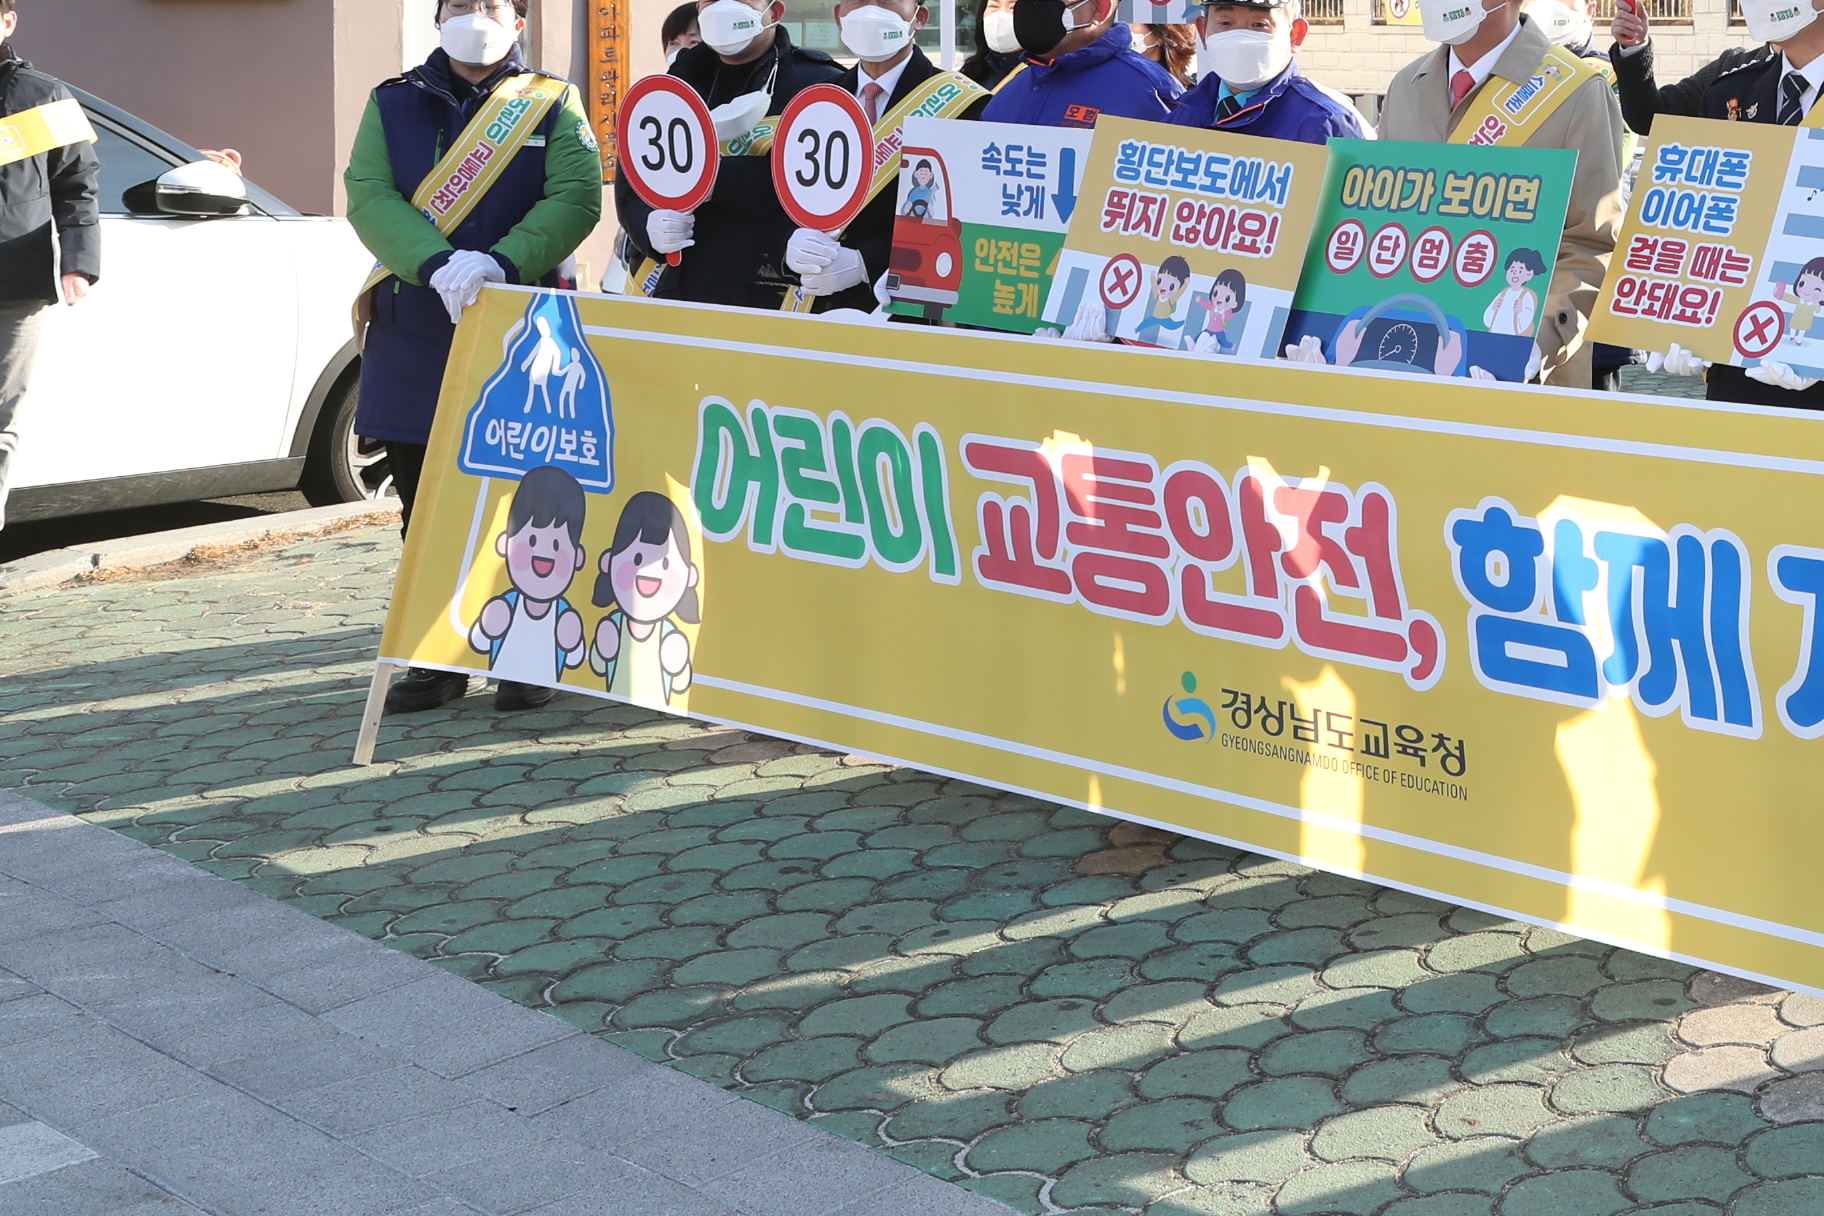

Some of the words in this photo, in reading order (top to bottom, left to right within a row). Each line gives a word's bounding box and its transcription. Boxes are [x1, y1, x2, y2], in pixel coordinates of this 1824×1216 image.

[485, 98, 532, 145] 어린이
[639, 116, 693, 173] 30
[428, 141, 495, 215] 교통안전
[795, 128, 849, 190] 30
[982, 141, 1047, 180] 속도는
[1114, 140, 1293, 206] 횡단보도에서
[1653, 144, 1751, 190] 휴대폰
[1001, 183, 1046, 220] 낮게
[1341, 166, 1436, 214] 아이가
[1437, 171, 1541, 222] 보이면
[1641, 188, 1739, 235] 이어폰
[1102, 188, 1168, 239] 뛰지
[1171, 200, 1280, 256] 않아요!
[975, 238, 1041, 278] 안전은
[1626, 236, 1688, 275] 걸을
[1689, 245, 1751, 285] 때는
[992, 279, 1040, 319] 높게
[1611, 276, 1722, 326] 안돼요!
[485, 418, 600, 466] 어린이보호
[698, 399, 958, 583] 어린이
[961, 437, 1441, 684] 교통안전,
[1448, 501, 1757, 734] 함께
[1221, 687, 1467, 777] 경상남도교육청
[1221, 732, 1338, 772] GYEONGSANGNAMDO
[1342, 759, 1380, 782] OFFICE
[1382, 768, 1397, 785] OF
[1400, 772, 1468, 801] EDUCATION
